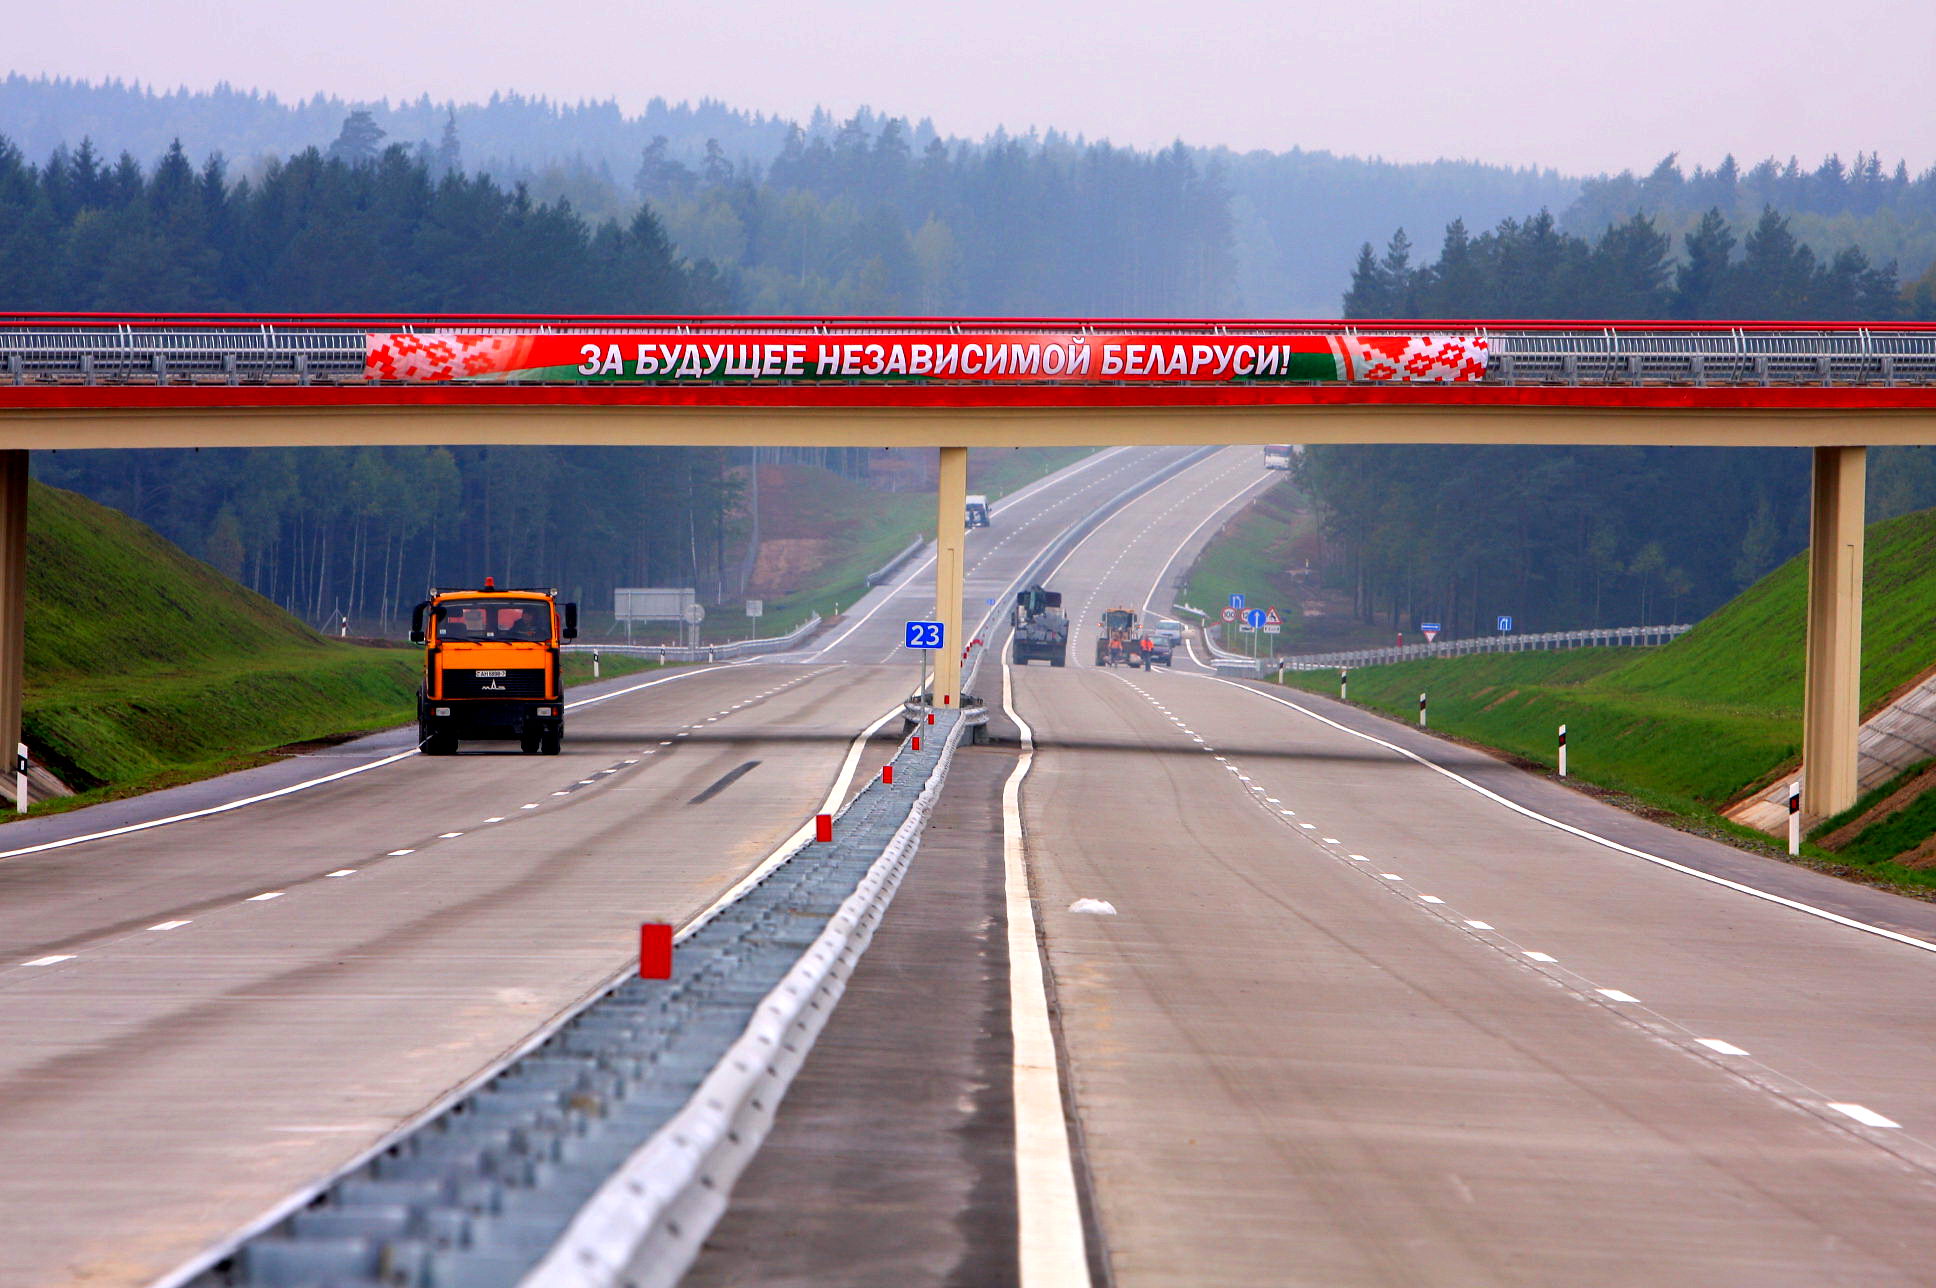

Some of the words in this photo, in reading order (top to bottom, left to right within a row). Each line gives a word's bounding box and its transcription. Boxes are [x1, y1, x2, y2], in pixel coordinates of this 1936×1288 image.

[578, 344, 624, 375] ЗА
[635, 344, 807, 378] БУДУЩЕЕ
[816, 336, 1091, 376] НЕЗАВИСИМОЙ
[1100, 344, 1291, 375] БЕЛАРУСИ!
[911, 624, 940, 646] 23
